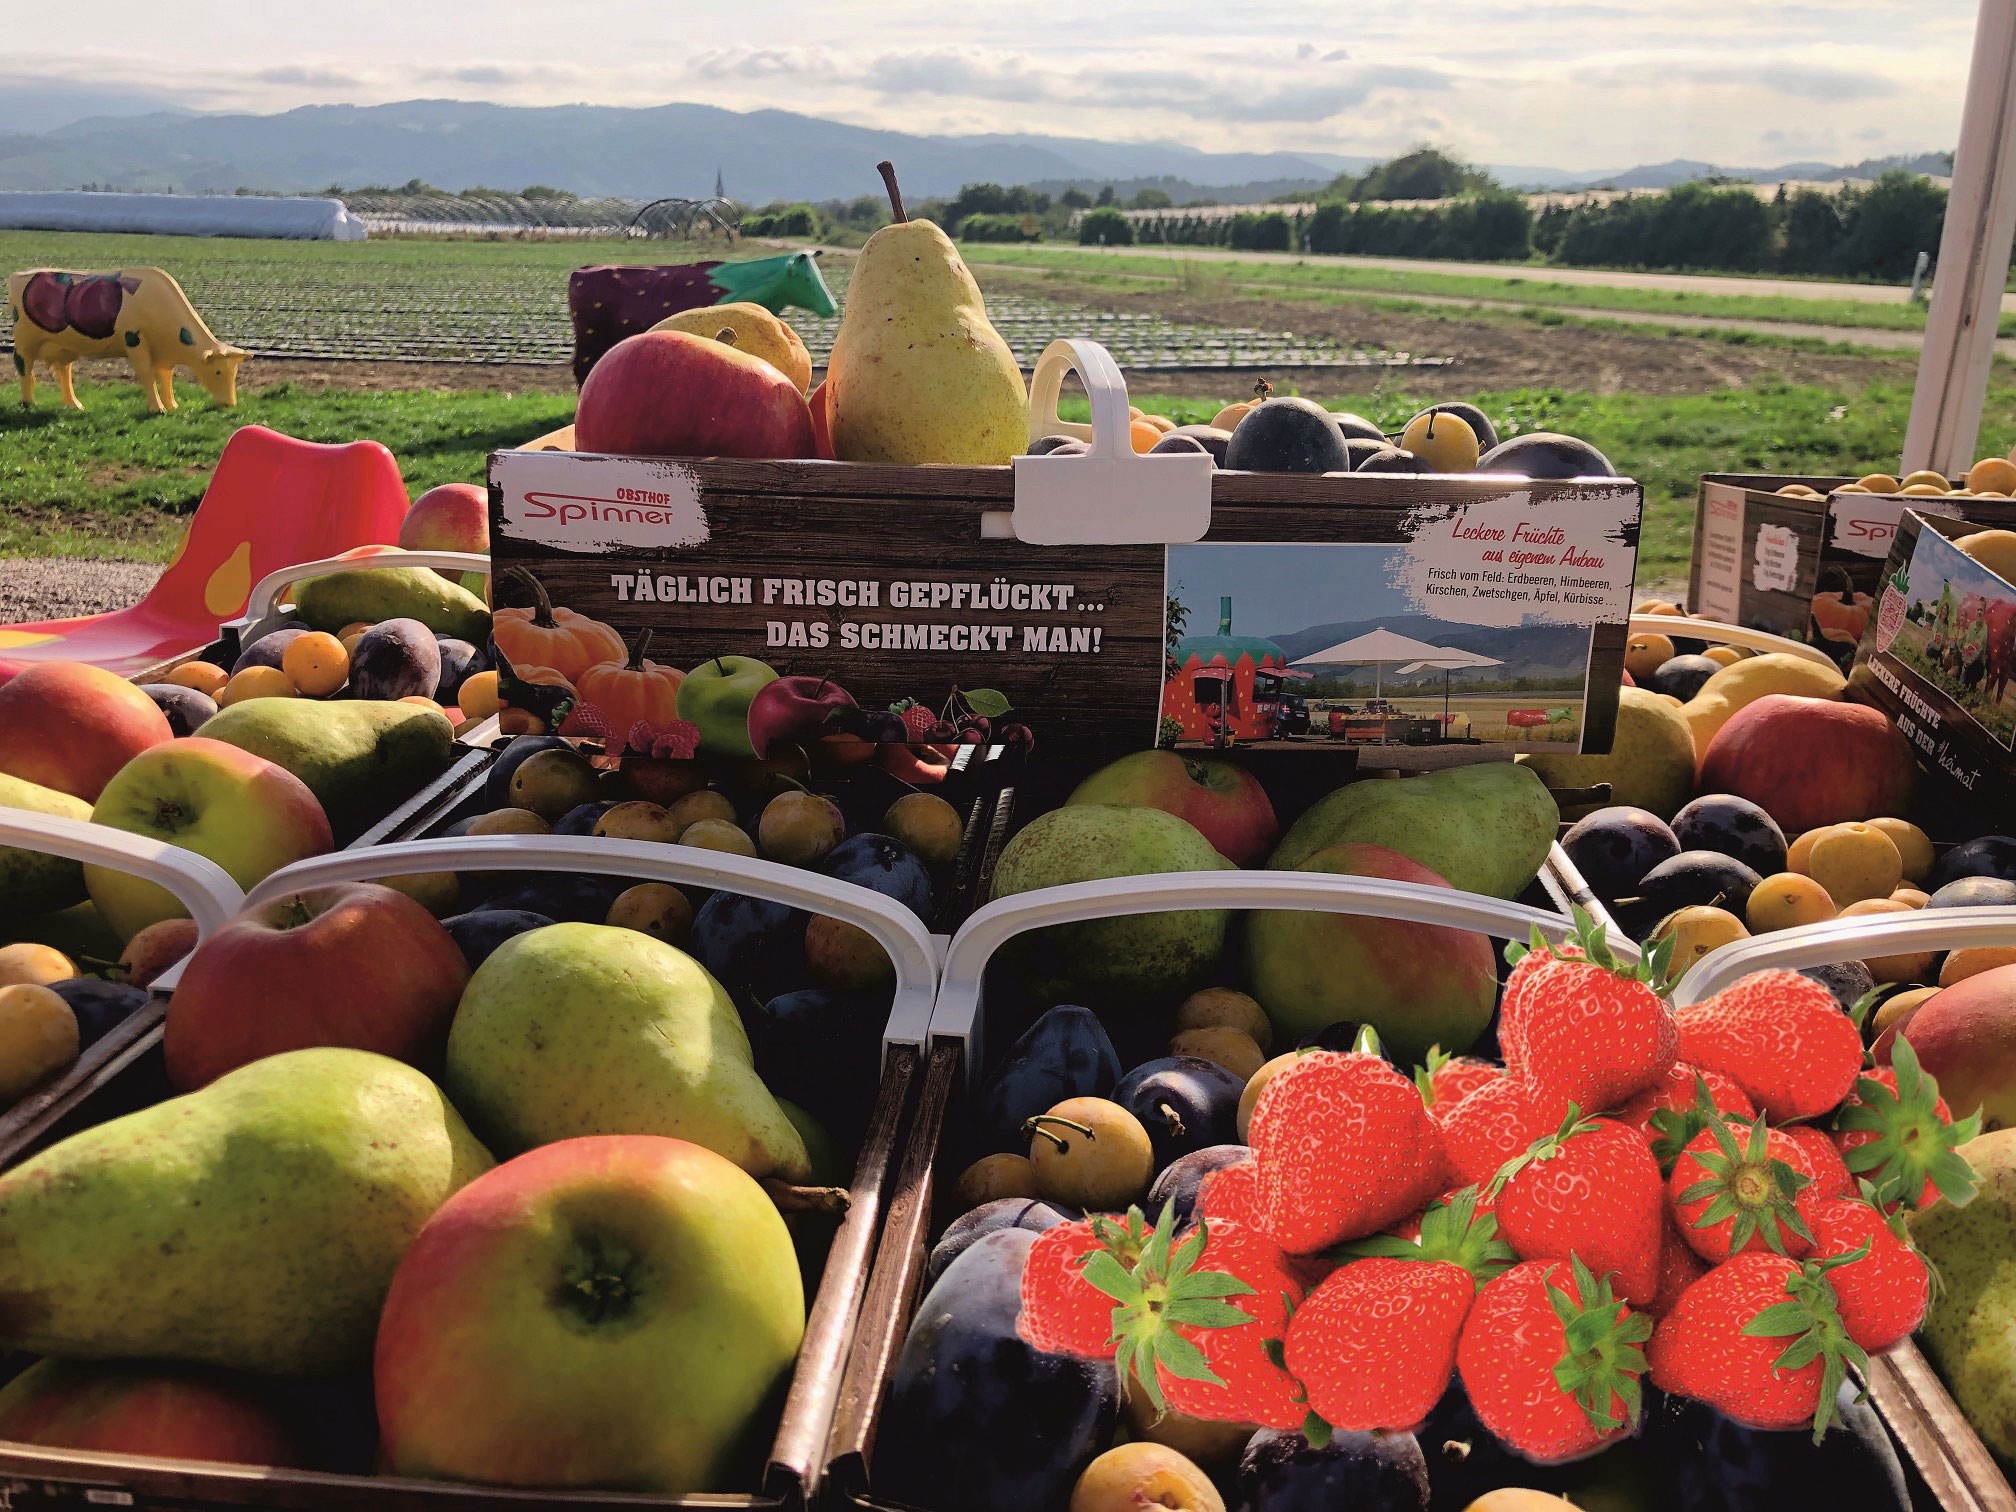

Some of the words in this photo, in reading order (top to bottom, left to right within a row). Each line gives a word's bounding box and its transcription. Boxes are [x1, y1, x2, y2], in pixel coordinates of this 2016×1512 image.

[524, 491, 672, 526] Spinner
[616, 487, 670, 505] OBSTHOF
[1452, 517, 1505, 542] Leckere
[1512, 522, 1565, 546] Früchte
[1482, 549, 1503, 563] aus
[1508, 550, 1556, 570] eigenem
[1559, 545, 1605, 569] Anbau
[611, 568, 752, 604] TÄGLICH
[763, 578, 880, 607] FRISCH
[890, 577, 1104, 611] GEPFLÜCKT...
[1425, 583, 1469, 598] Kirschen,
[1472, 586, 1531, 604] Zwetschgen,
[1533, 588, 1561, 605] Äpfel,
[1428, 567, 1457, 580] Frisch
[1460, 571, 1479, 582] vom
[1482, 570, 1505, 583] Feld:
[1507, 573, 1557, 588] Erdbeeren,
[1560, 575, 1612, 591] Himbeeren,
[766, 621, 829, 648] DAS
[840, 622, 1013, 651] SCHMECKT
[1023, 626, 1102, 653] MAN!
[1866, 653, 1901, 696] LECKERE
[1899, 684, 1941, 730] FRÜCHTE
[1896, 713, 1916, 738] AUS
[1915, 728, 1935, 756] DER
